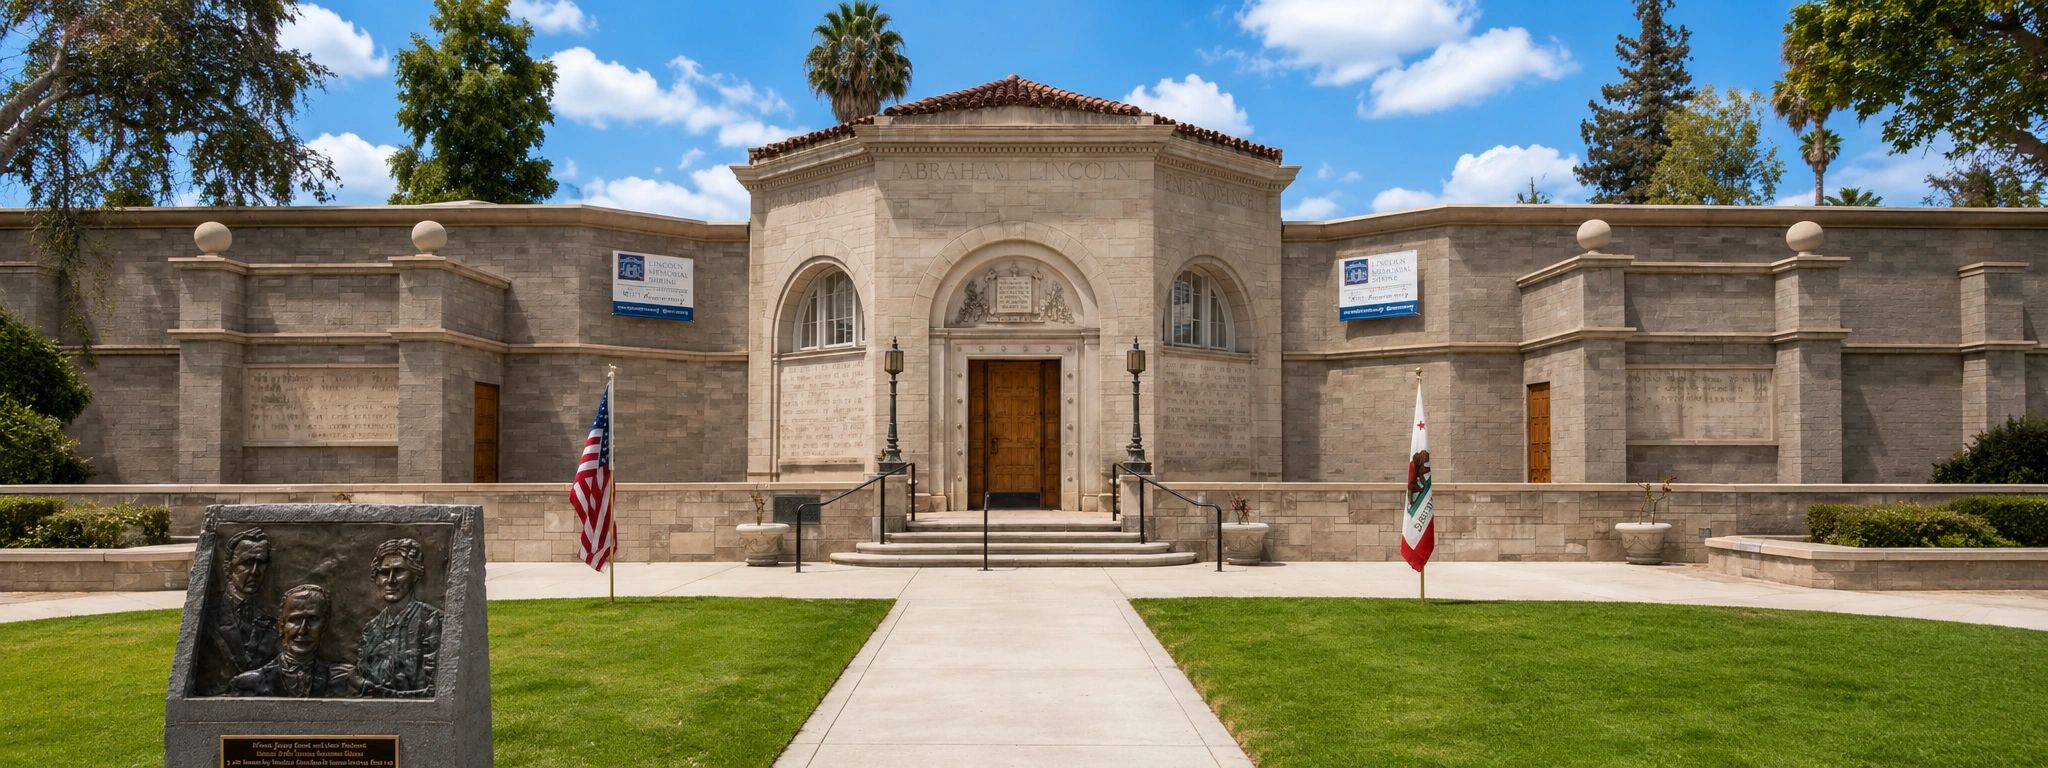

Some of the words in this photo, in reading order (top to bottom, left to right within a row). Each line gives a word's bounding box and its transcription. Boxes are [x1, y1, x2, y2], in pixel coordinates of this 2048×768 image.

[898, 162, 1009, 180] ABRAHAM
[1030, 162, 1131, 180] LINCOLN
[648, 261, 683, 270] LINCOLN
